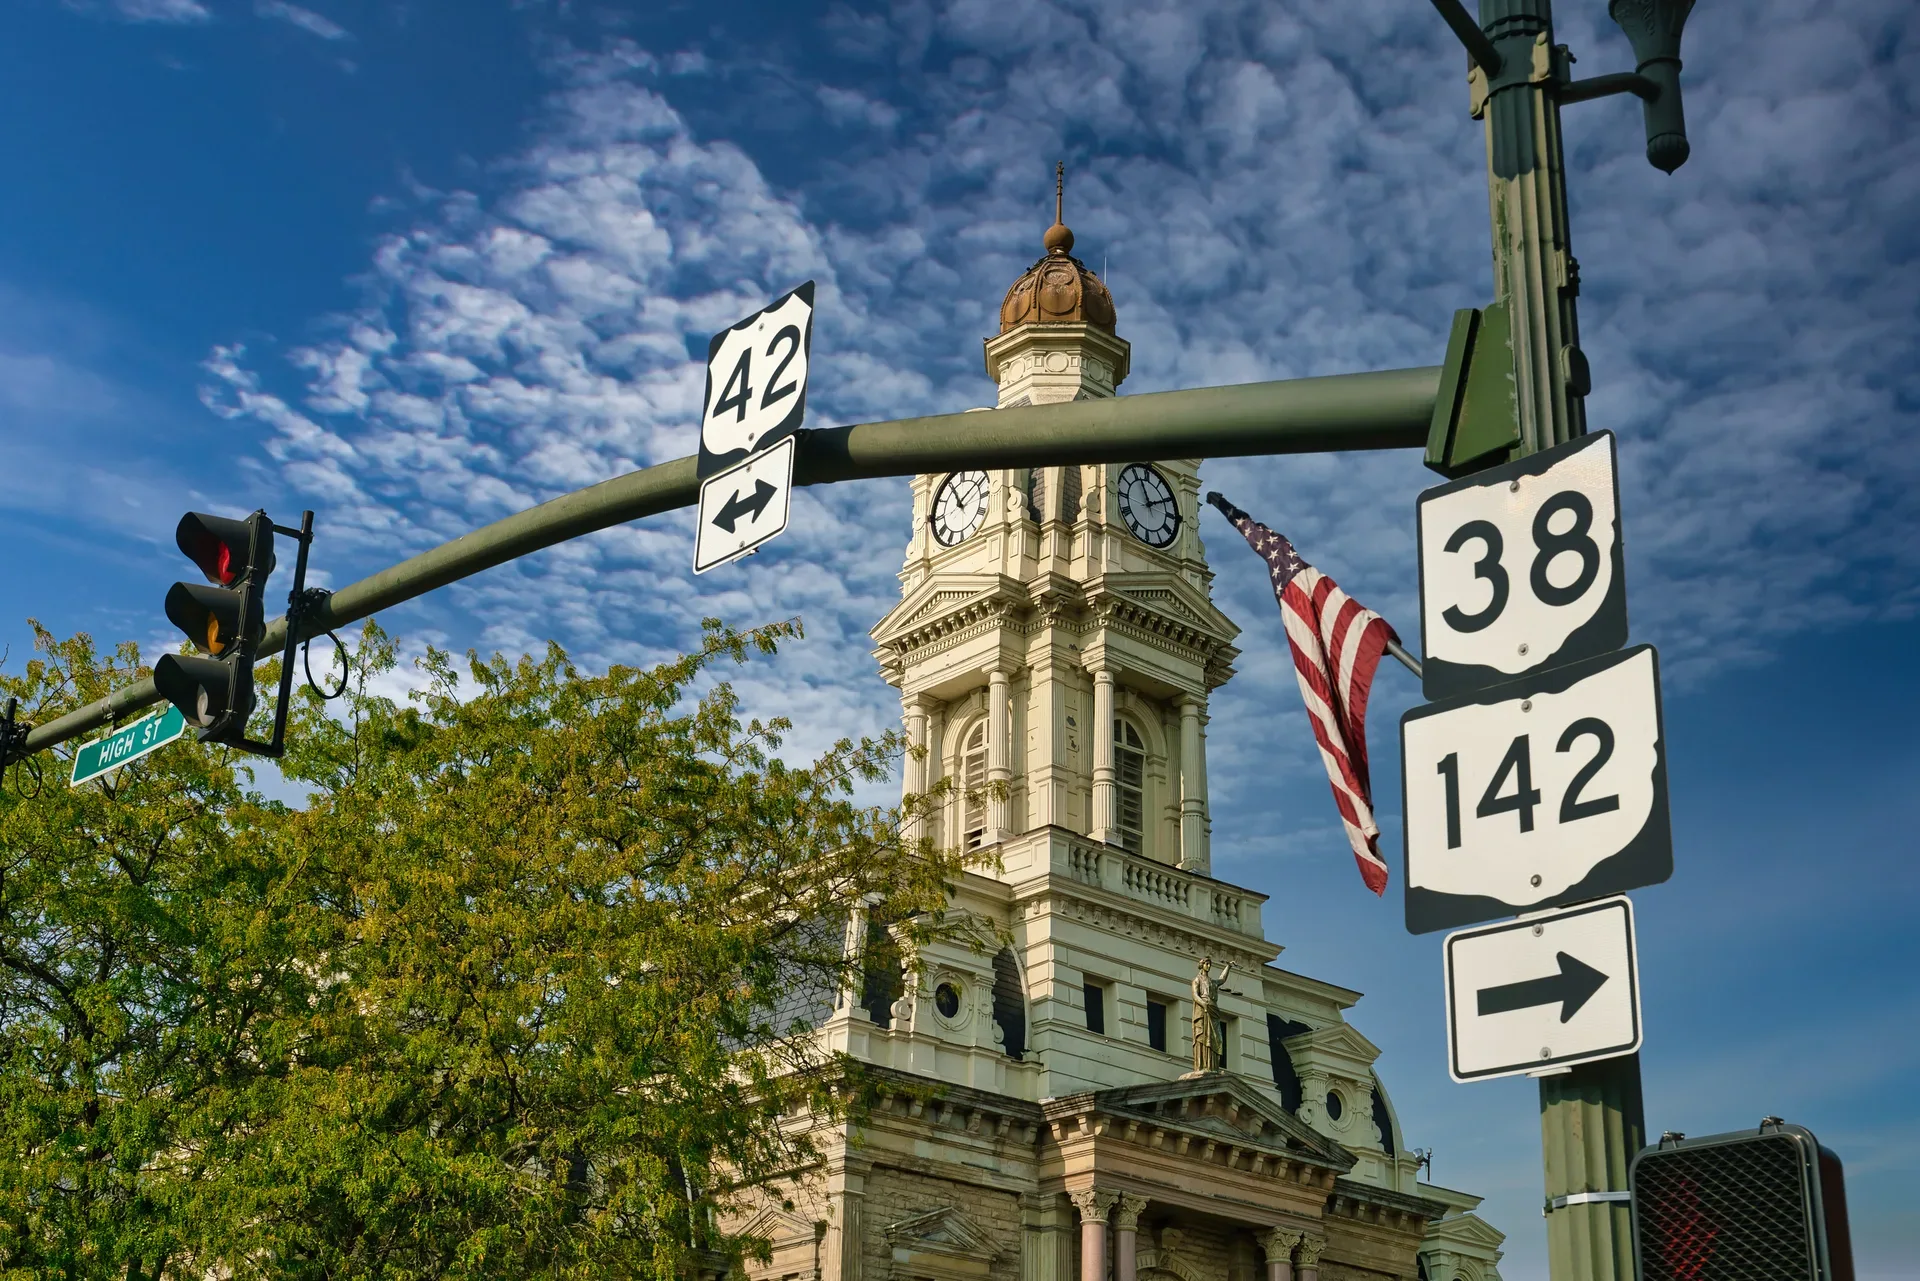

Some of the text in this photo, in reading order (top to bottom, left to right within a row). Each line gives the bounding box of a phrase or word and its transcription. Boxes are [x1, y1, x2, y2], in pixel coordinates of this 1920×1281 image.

[712, 324, 801, 423] 42
[1441, 490, 1601, 633] 38
[98, 718, 163, 767] HIGH ST
[1437, 717, 1620, 850] 142
